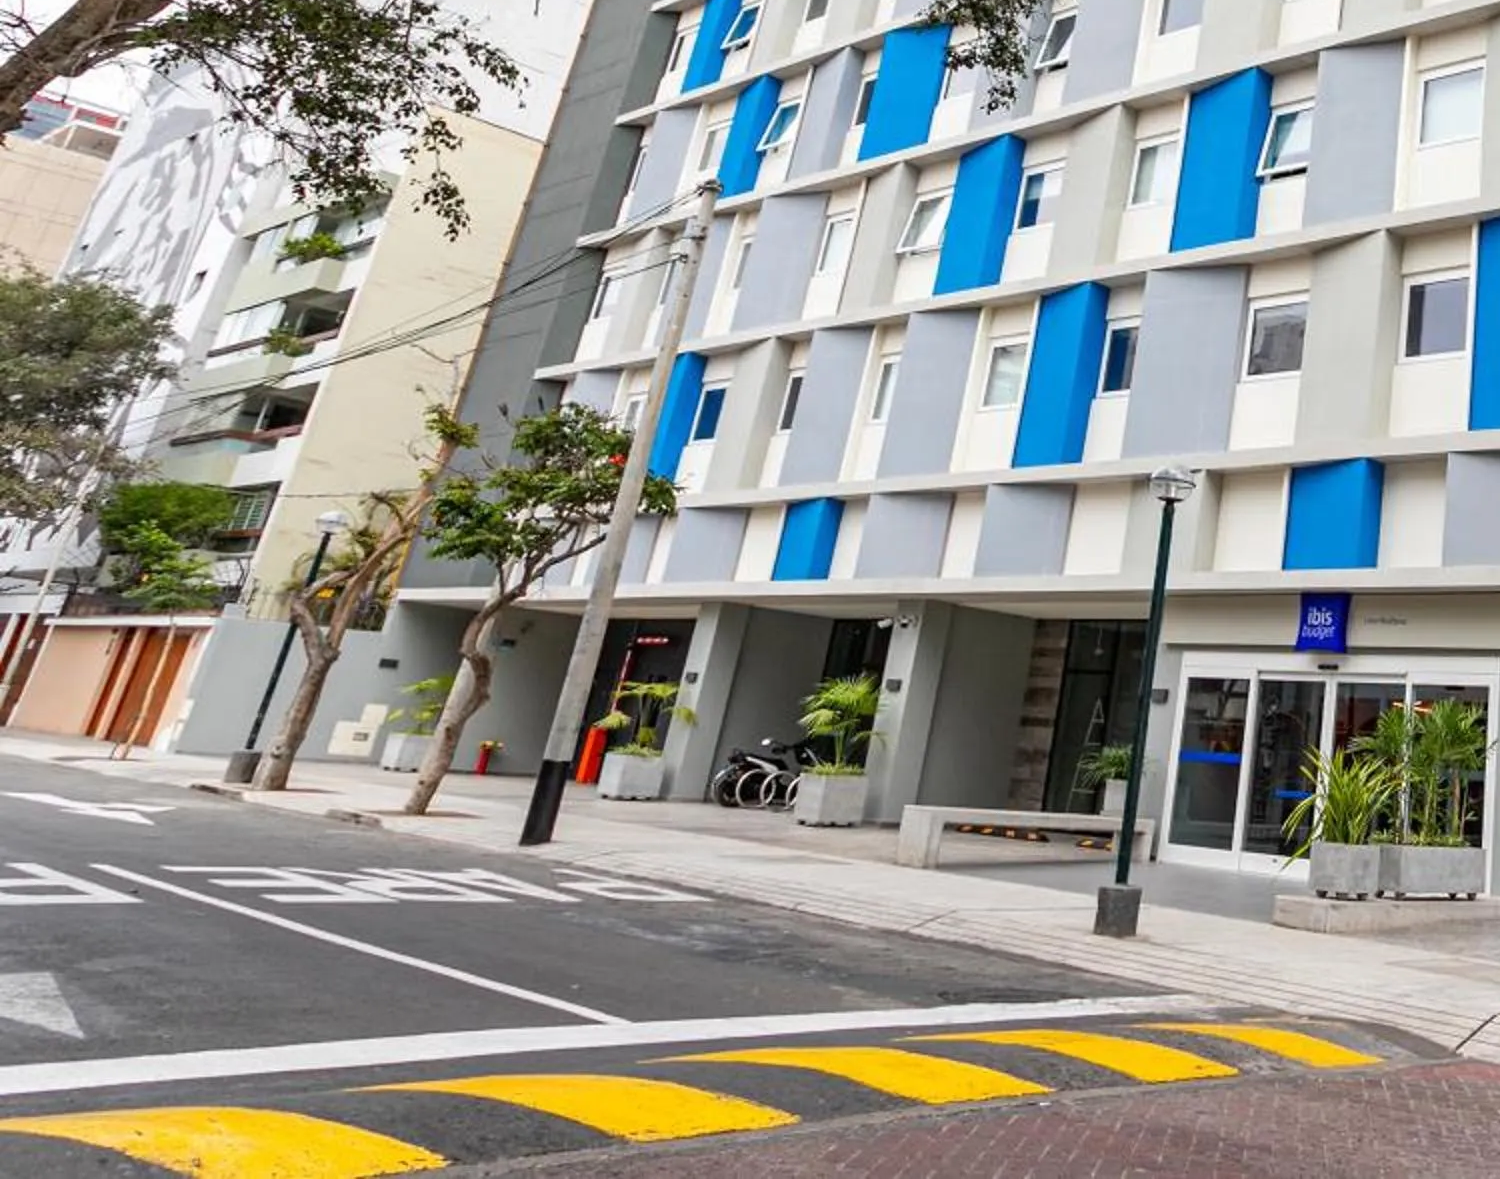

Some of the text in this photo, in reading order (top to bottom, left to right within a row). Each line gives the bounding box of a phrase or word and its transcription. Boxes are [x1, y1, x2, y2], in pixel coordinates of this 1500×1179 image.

[1307, 606, 1333, 625] ibis
[1302, 625, 1335, 639] budget
[160, 864, 715, 904] PARE
